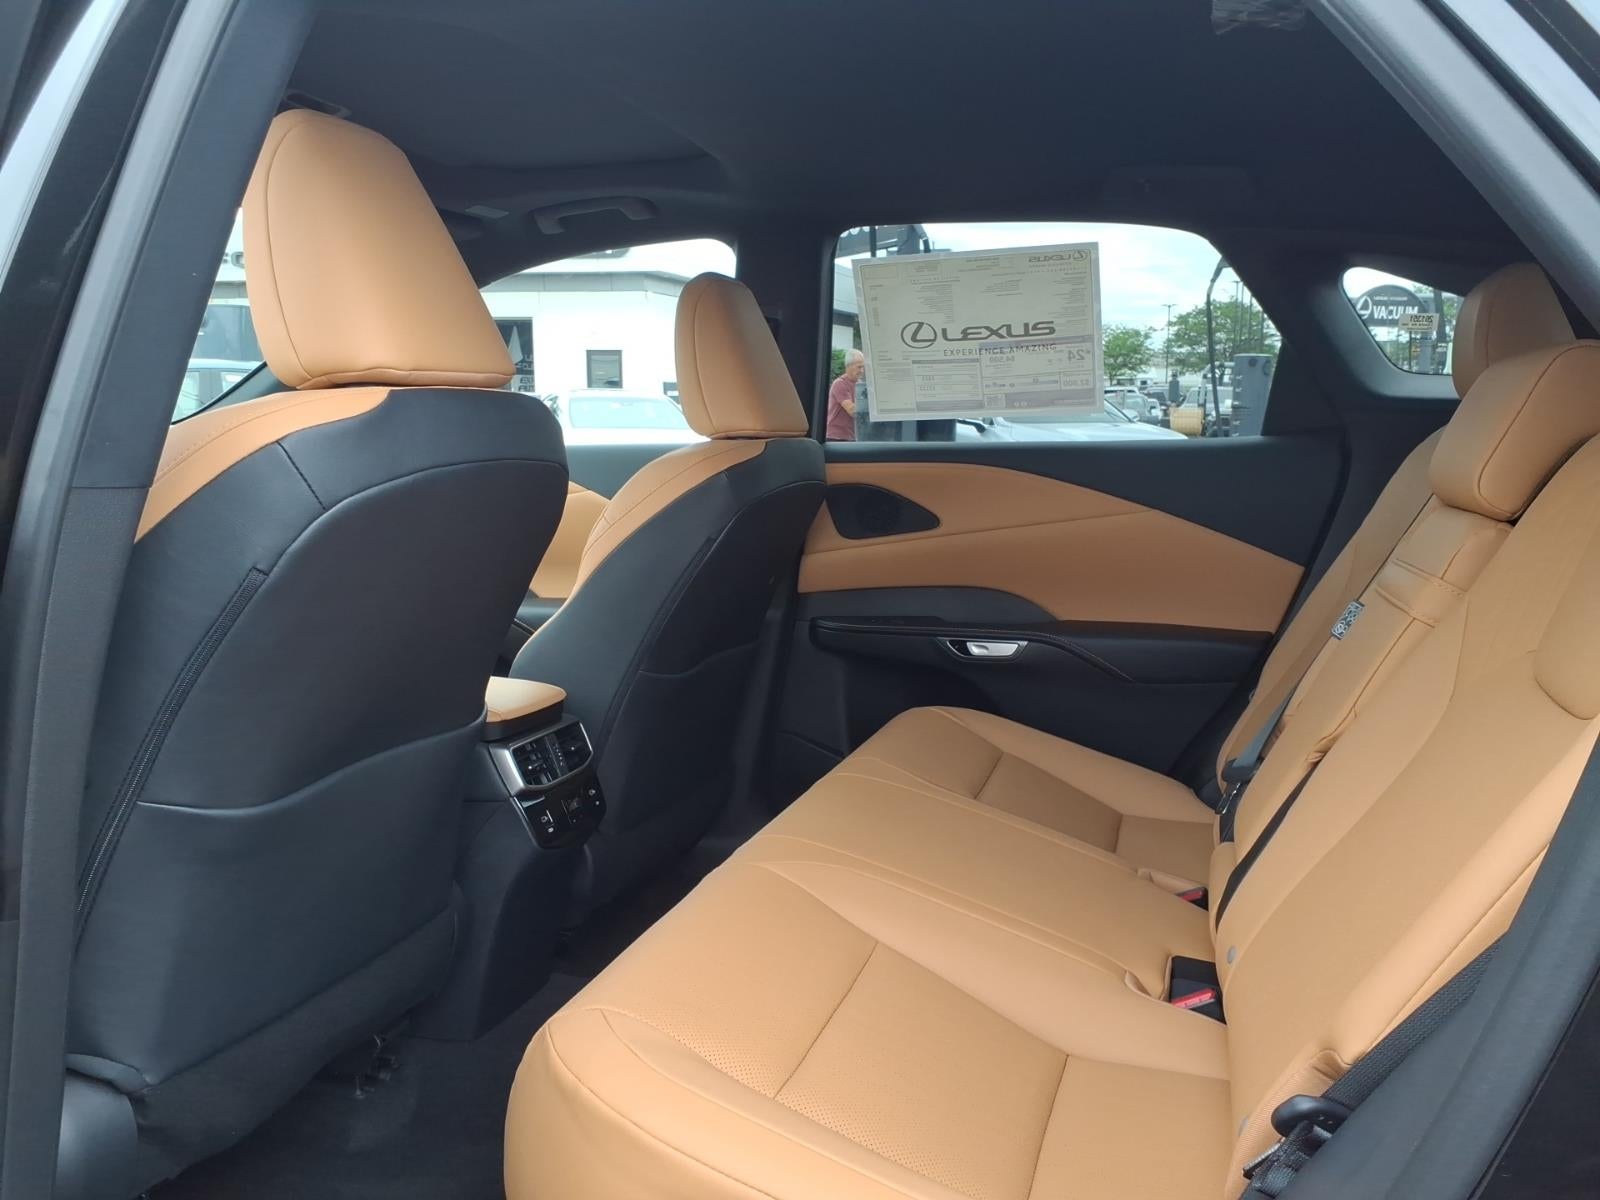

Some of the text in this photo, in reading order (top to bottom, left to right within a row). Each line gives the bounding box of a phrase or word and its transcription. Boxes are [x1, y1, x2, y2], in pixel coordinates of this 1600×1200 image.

[1373, 304, 1418, 319] VACUUM
[941, 321, 1056, 342] LEXUS
[943, 346, 1006, 357] EXPERIENCE
[1009, 342, 1057, 353] AMAZING
